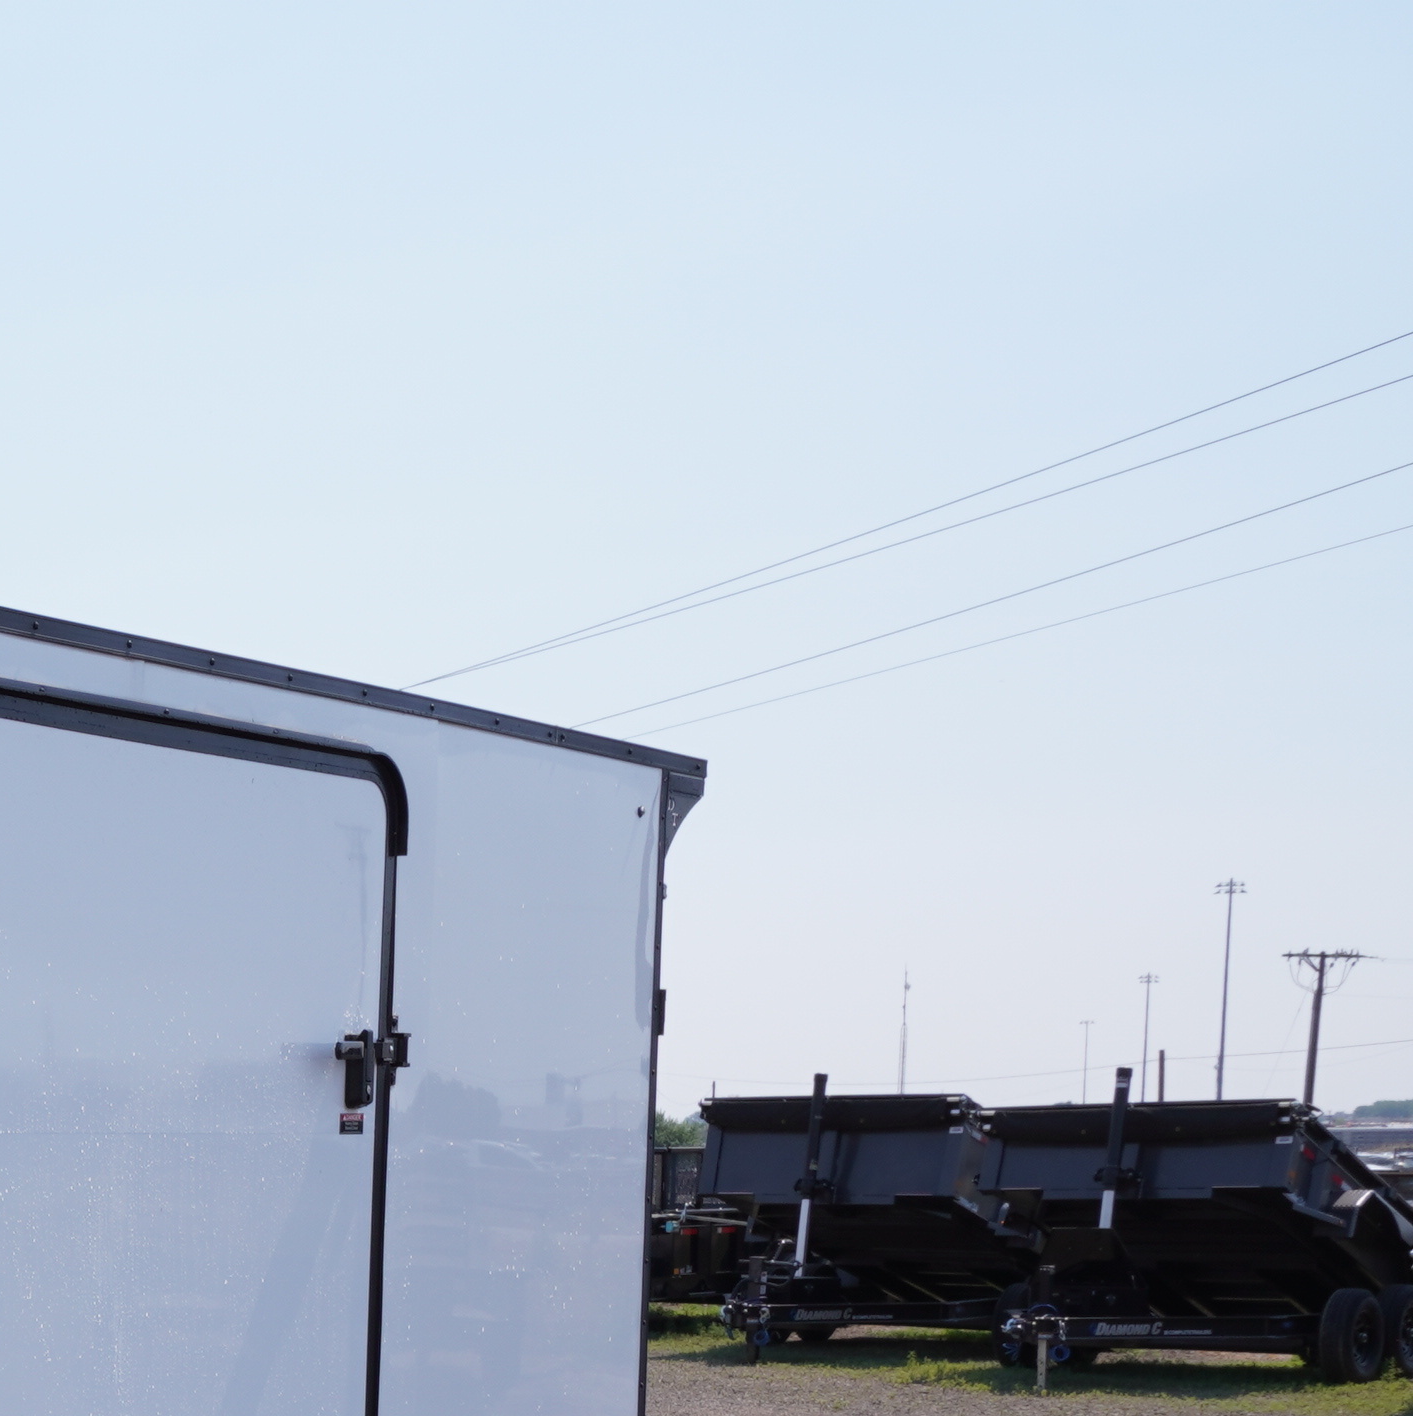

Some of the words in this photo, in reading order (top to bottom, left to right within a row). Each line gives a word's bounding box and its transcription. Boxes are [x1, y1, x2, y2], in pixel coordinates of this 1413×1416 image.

[794, 1308, 842, 1321] DIAMOND
[842, 1307, 853, 1320] C
[1095, 1322, 1151, 1336] DIAMOND
[1152, 1321, 1163, 1335] C
